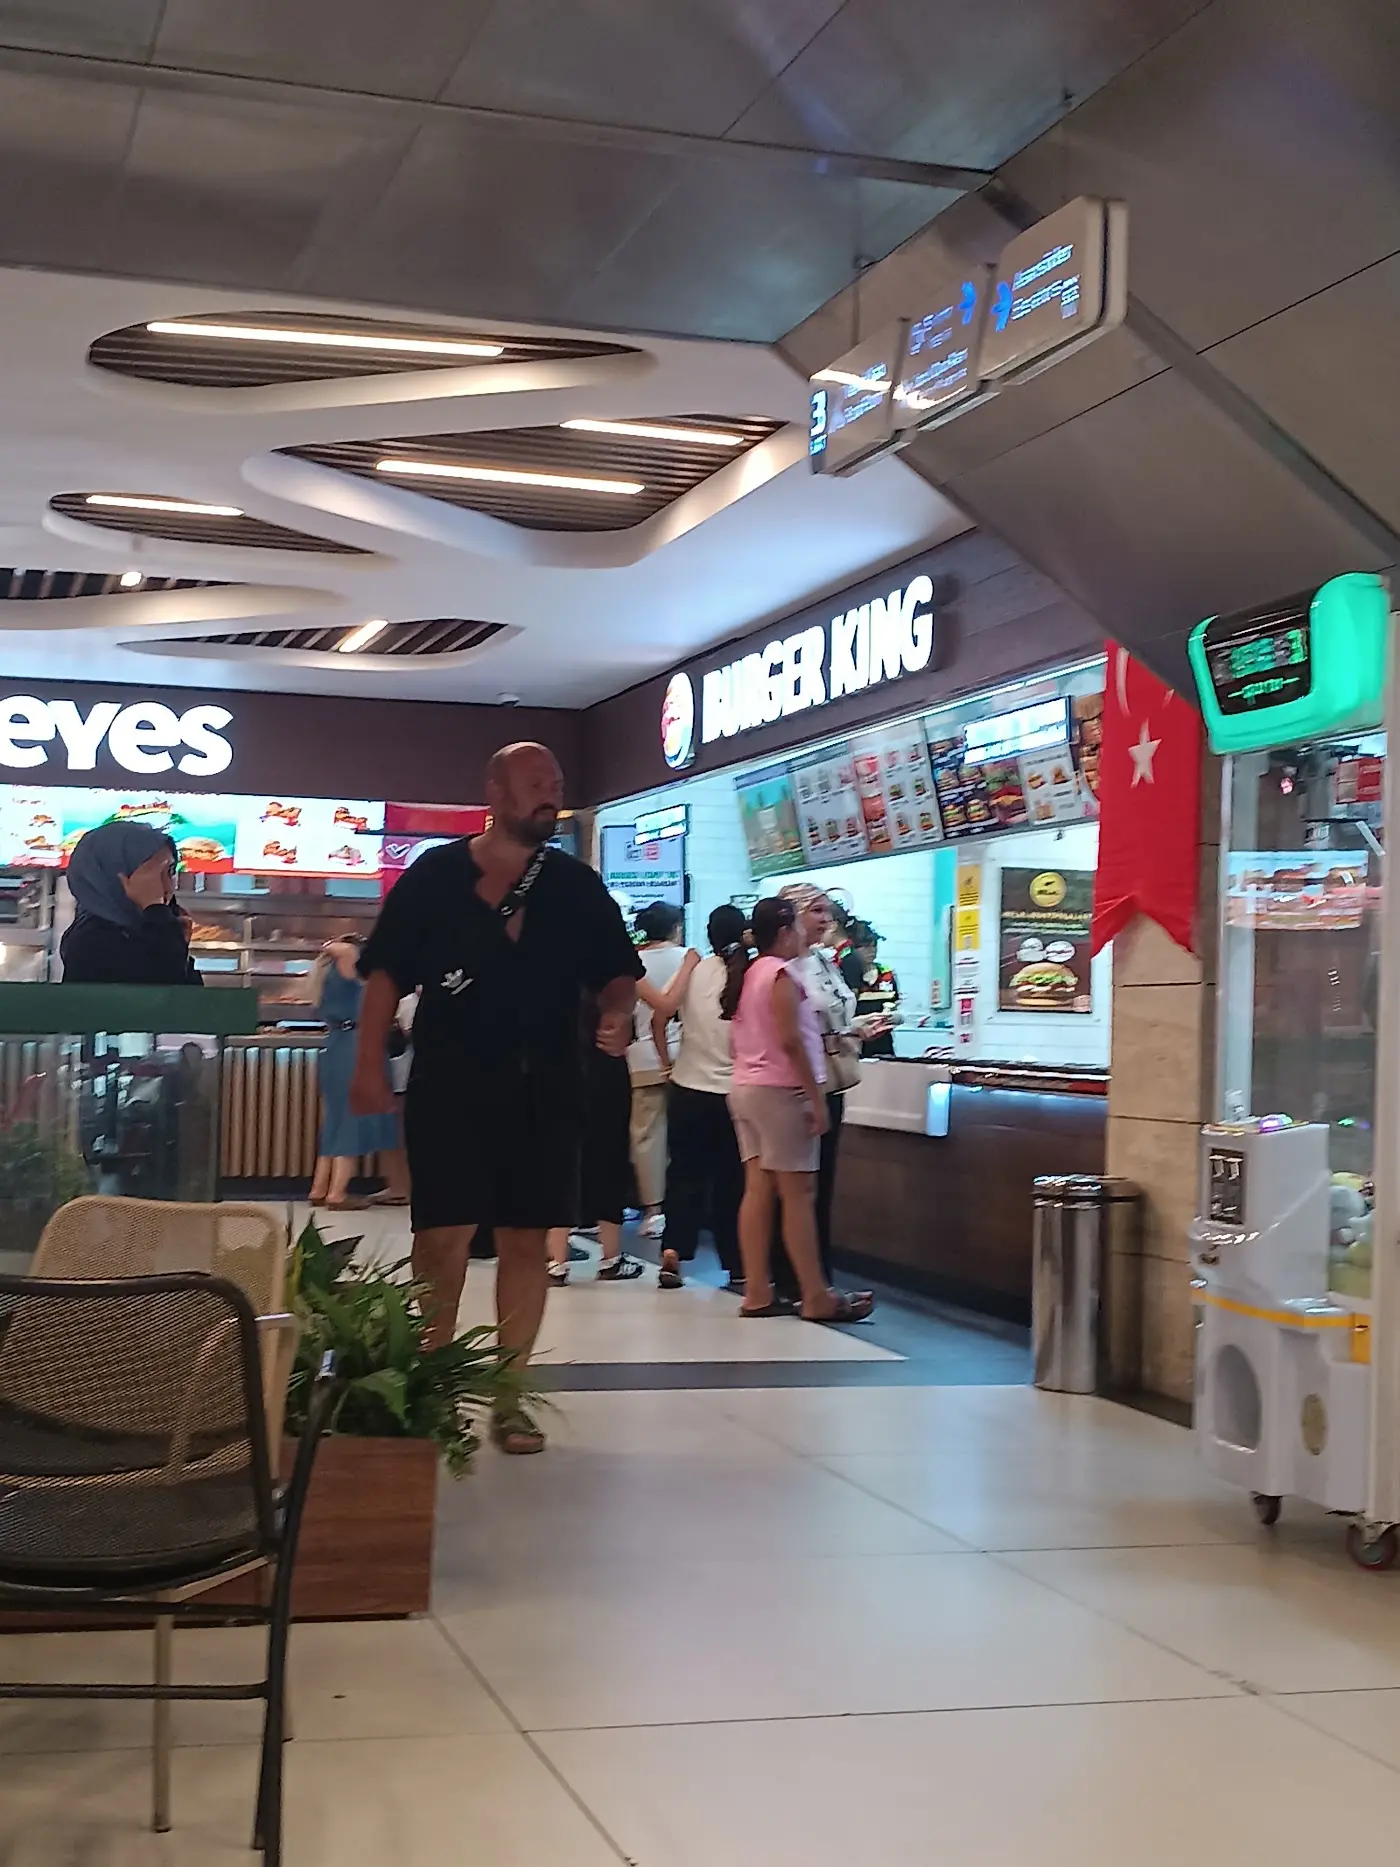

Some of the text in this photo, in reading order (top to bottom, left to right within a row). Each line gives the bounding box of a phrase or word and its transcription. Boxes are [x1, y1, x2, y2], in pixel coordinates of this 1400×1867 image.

[701, 625, 827, 744] BURGER
[829, 575, 934, 699] KING
[0, 694, 234, 777] eyes
